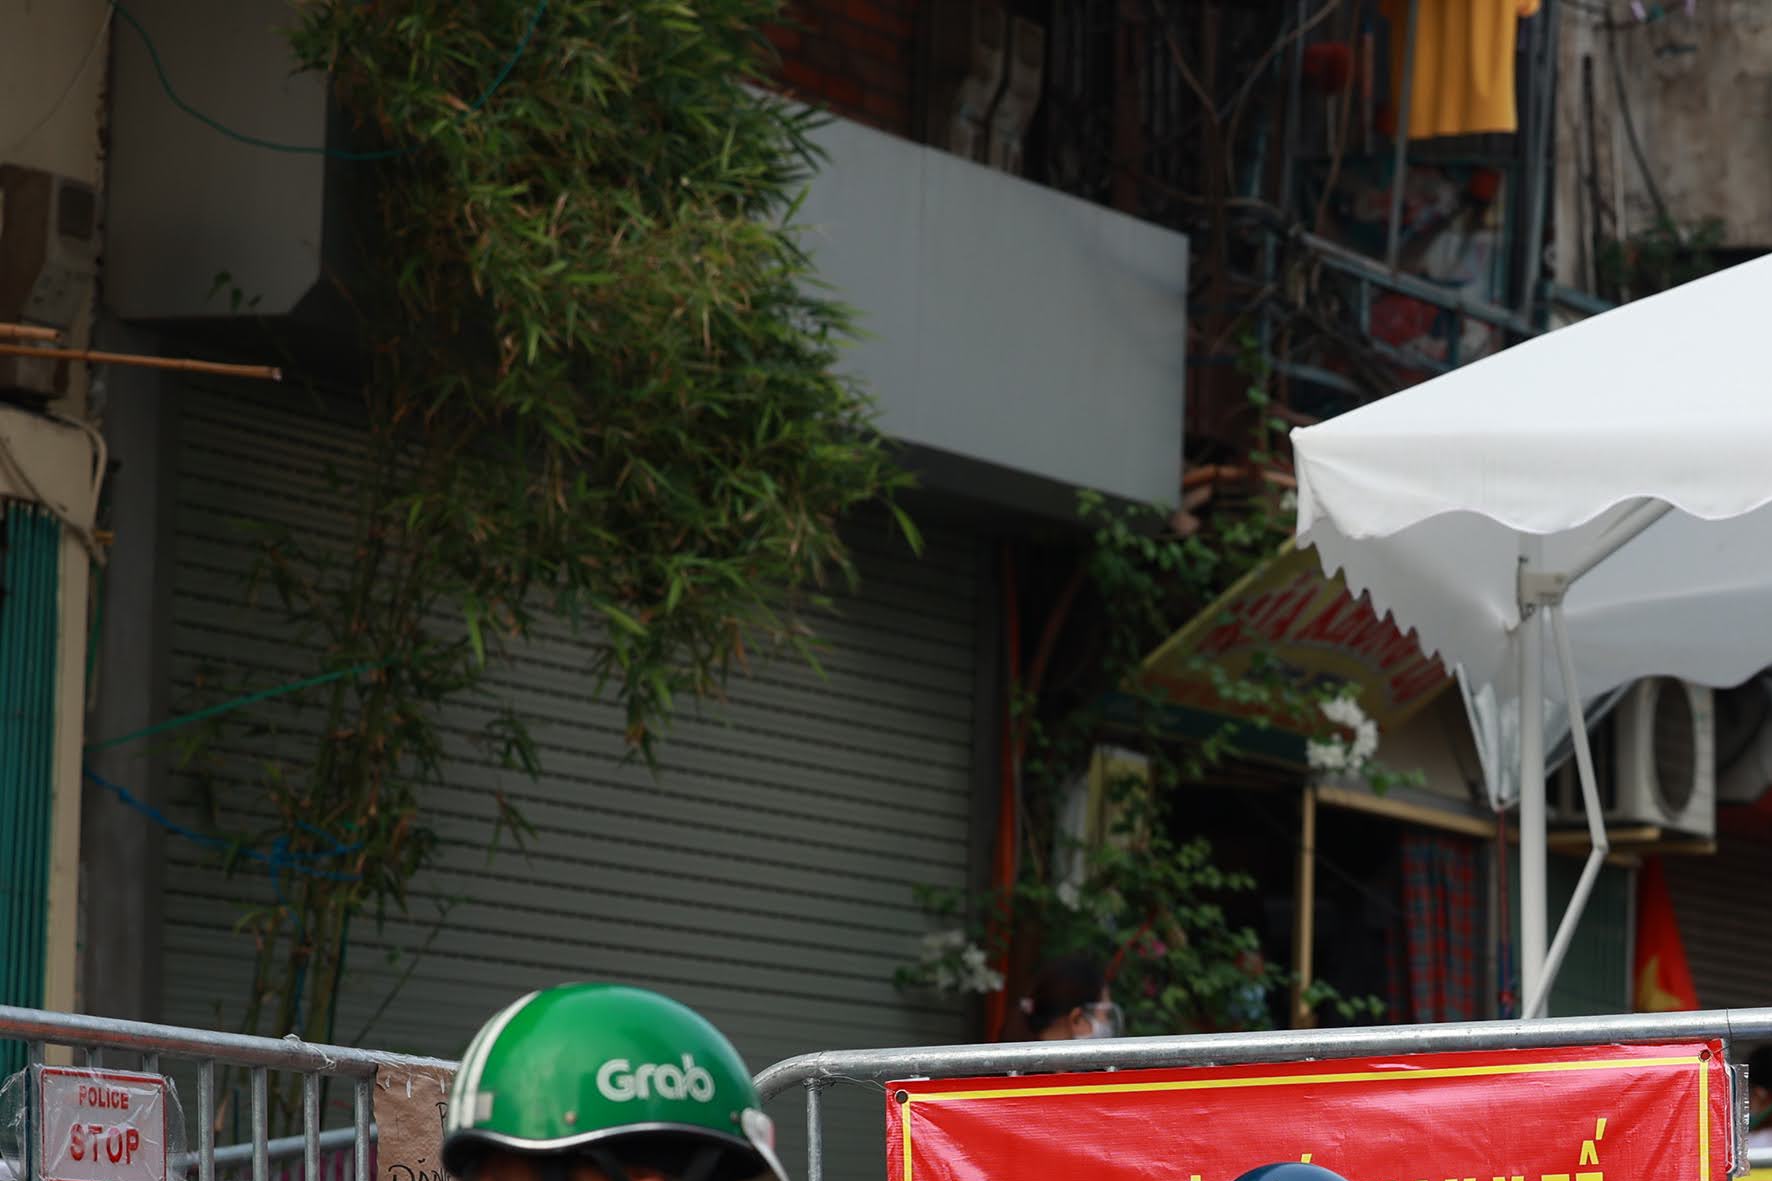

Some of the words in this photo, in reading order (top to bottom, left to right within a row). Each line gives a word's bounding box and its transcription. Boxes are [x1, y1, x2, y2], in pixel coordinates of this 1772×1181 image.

[79, 1085, 129, 1110] POLICE
[596, 1053, 716, 1102] Grab
[69, 1123, 140, 1165] STOP
